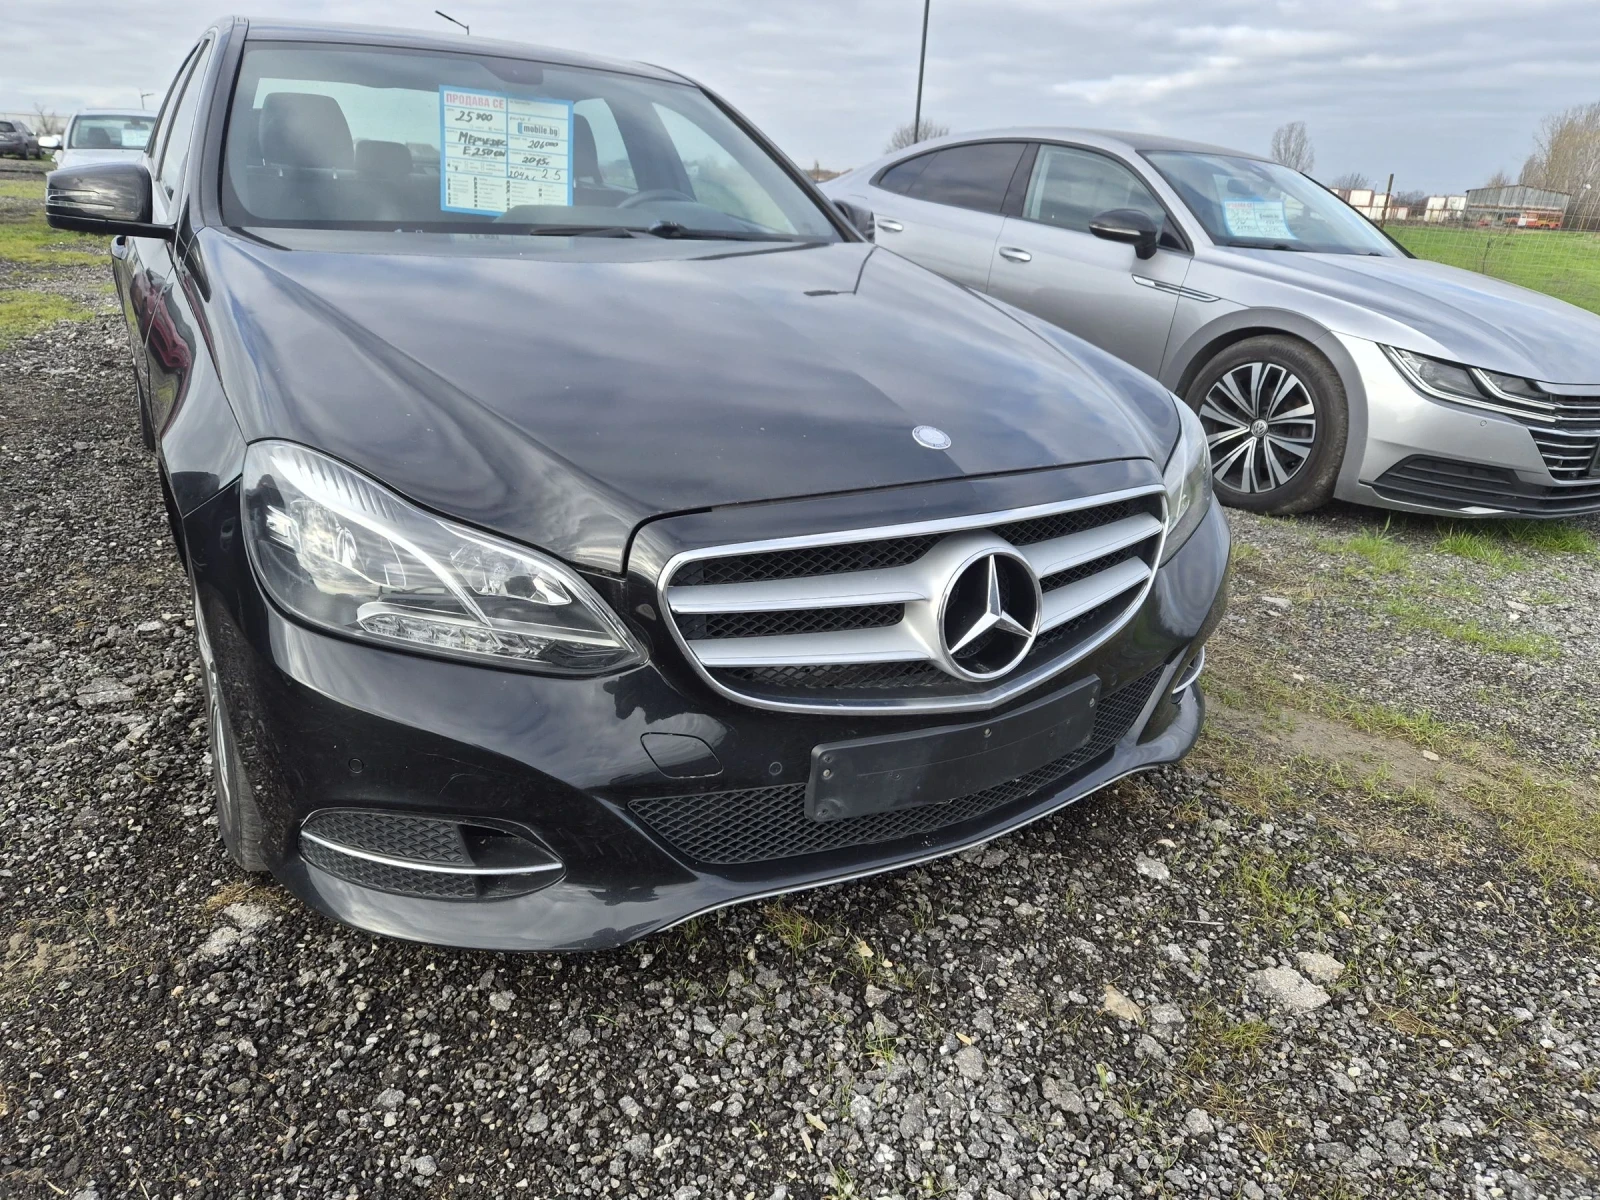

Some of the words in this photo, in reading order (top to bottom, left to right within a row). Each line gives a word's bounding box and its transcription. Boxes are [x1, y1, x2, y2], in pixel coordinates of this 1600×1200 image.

[446, 93, 490, 108] ПРОДАВА
[492, 98, 504, 109] СЕ
[523, 125, 558, 137] mobile.bg
